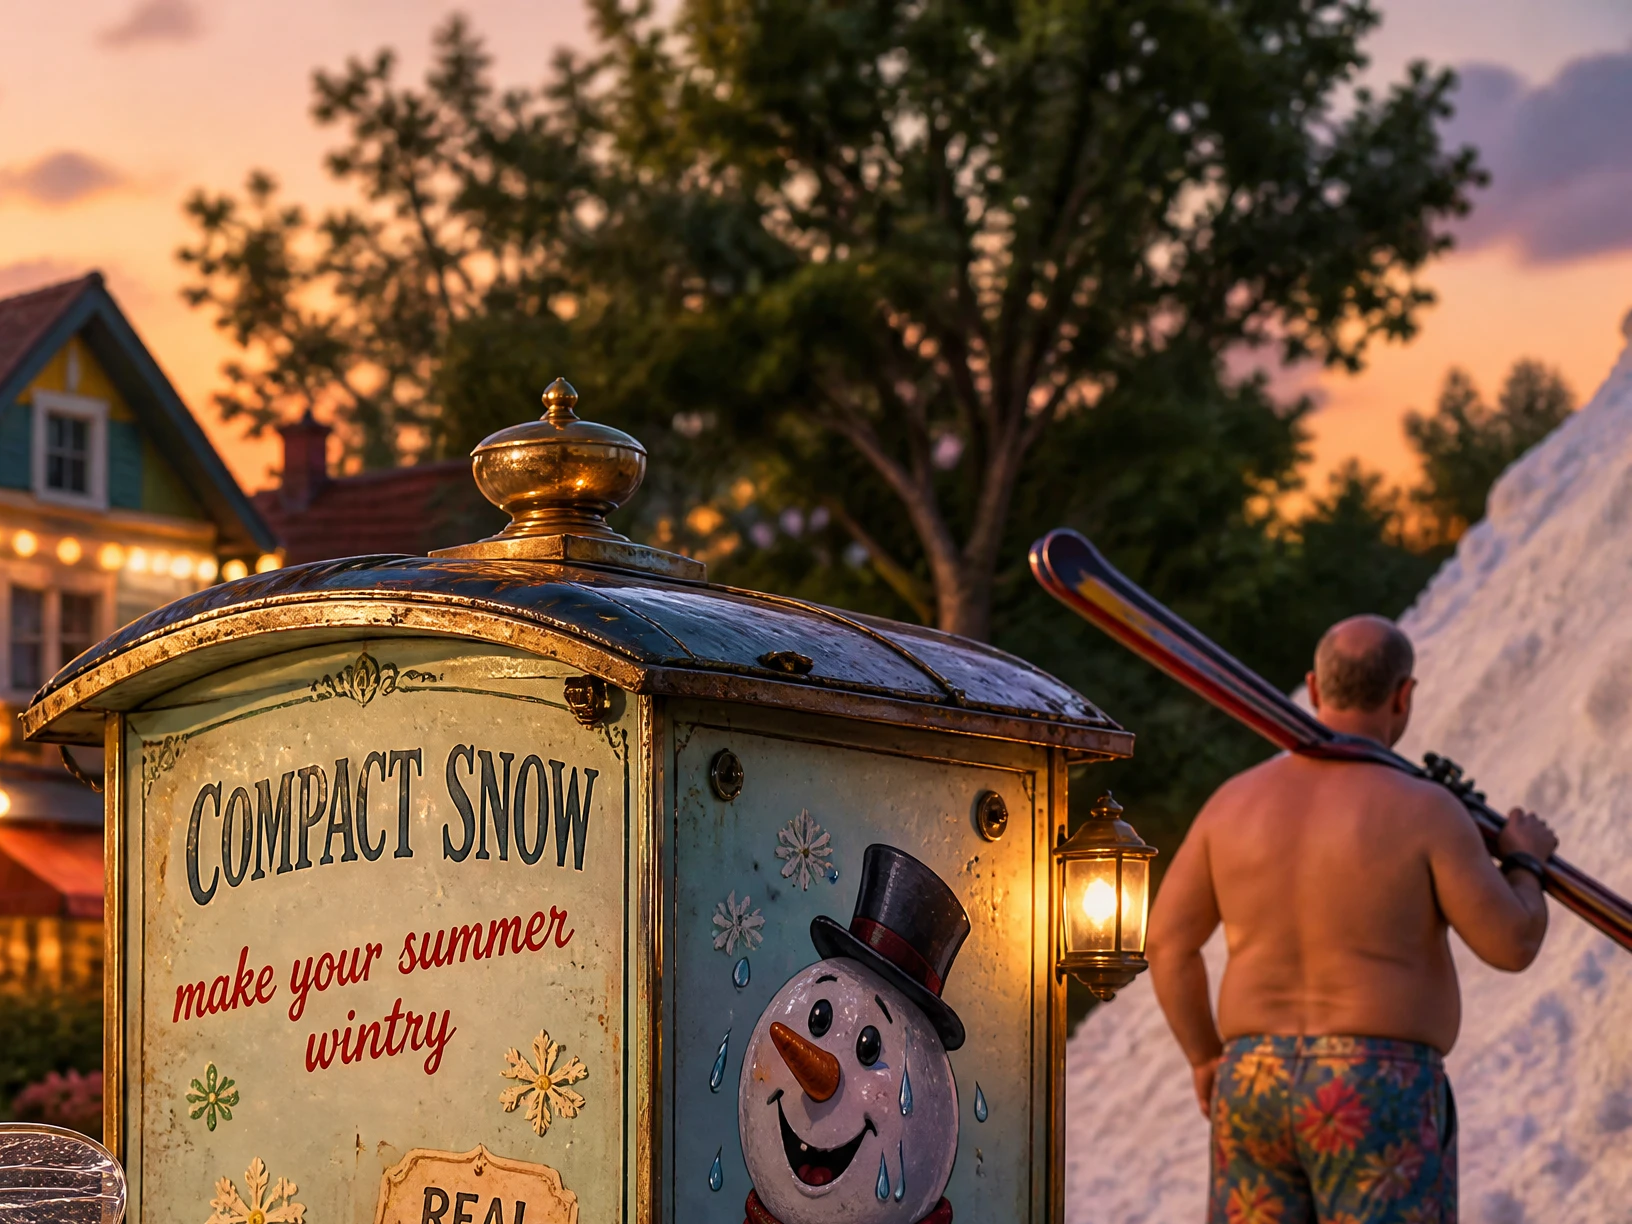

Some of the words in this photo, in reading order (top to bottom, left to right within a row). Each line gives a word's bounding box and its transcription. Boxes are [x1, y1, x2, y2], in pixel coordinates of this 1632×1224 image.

[185, 747, 423, 906] COMPACT
[441, 743, 600, 871] SNOW
[172, 945, 278, 1024] make
[288, 942, 382, 1021] your
[397, 904, 575, 976] summer
[304, 997, 457, 1075] wintry
